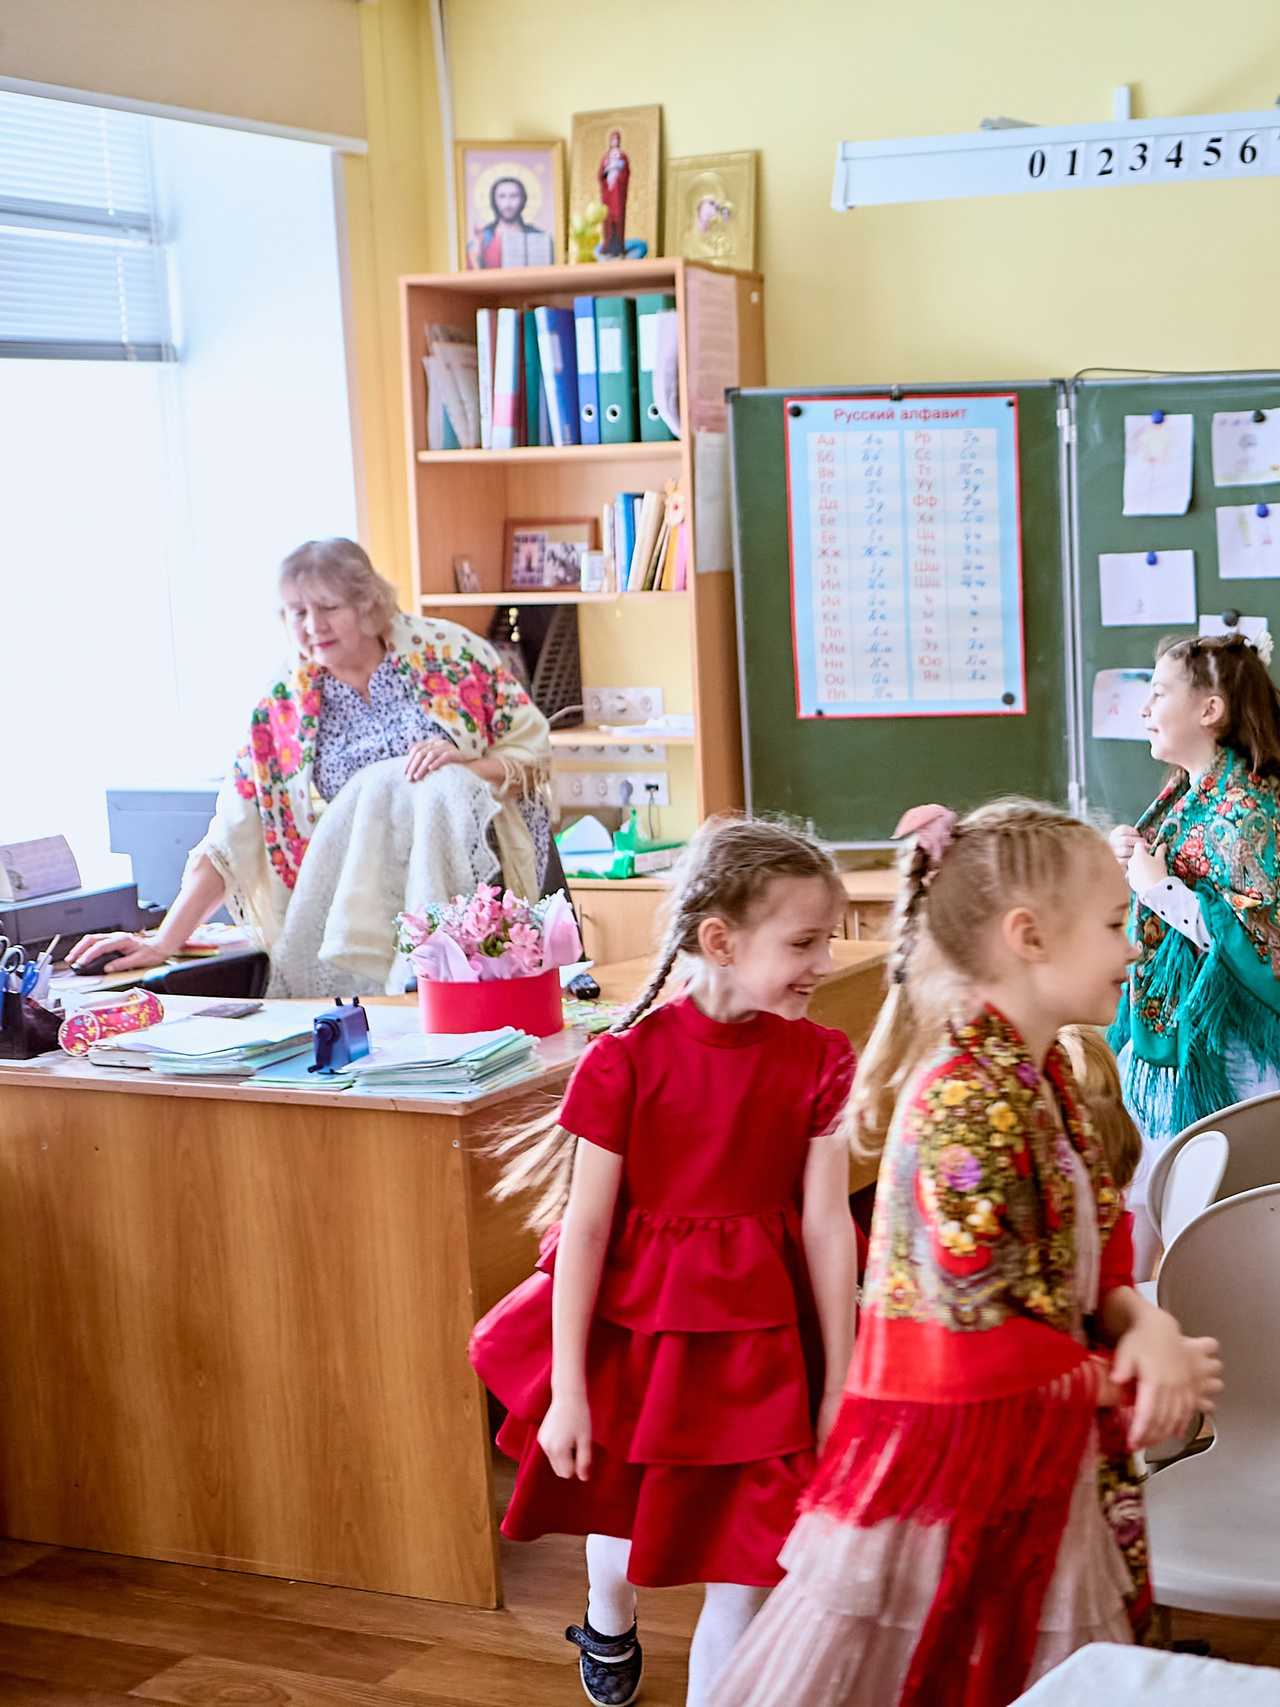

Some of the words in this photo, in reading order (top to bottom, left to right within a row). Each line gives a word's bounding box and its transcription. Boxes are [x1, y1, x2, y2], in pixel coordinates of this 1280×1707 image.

[1028, 149, 1047, 179] 0
[1066, 148, 1078, 176] 1
[1096, 147, 1114, 176] 2
[1129, 143, 1149, 171] 3
[1165, 140, 1184, 169] 4
[1203, 136, 1222, 166] 5
[1239, 134, 1259, 164] 6
[833, 407, 895, 424] Русский
[900, 407, 968, 422] алфавит
